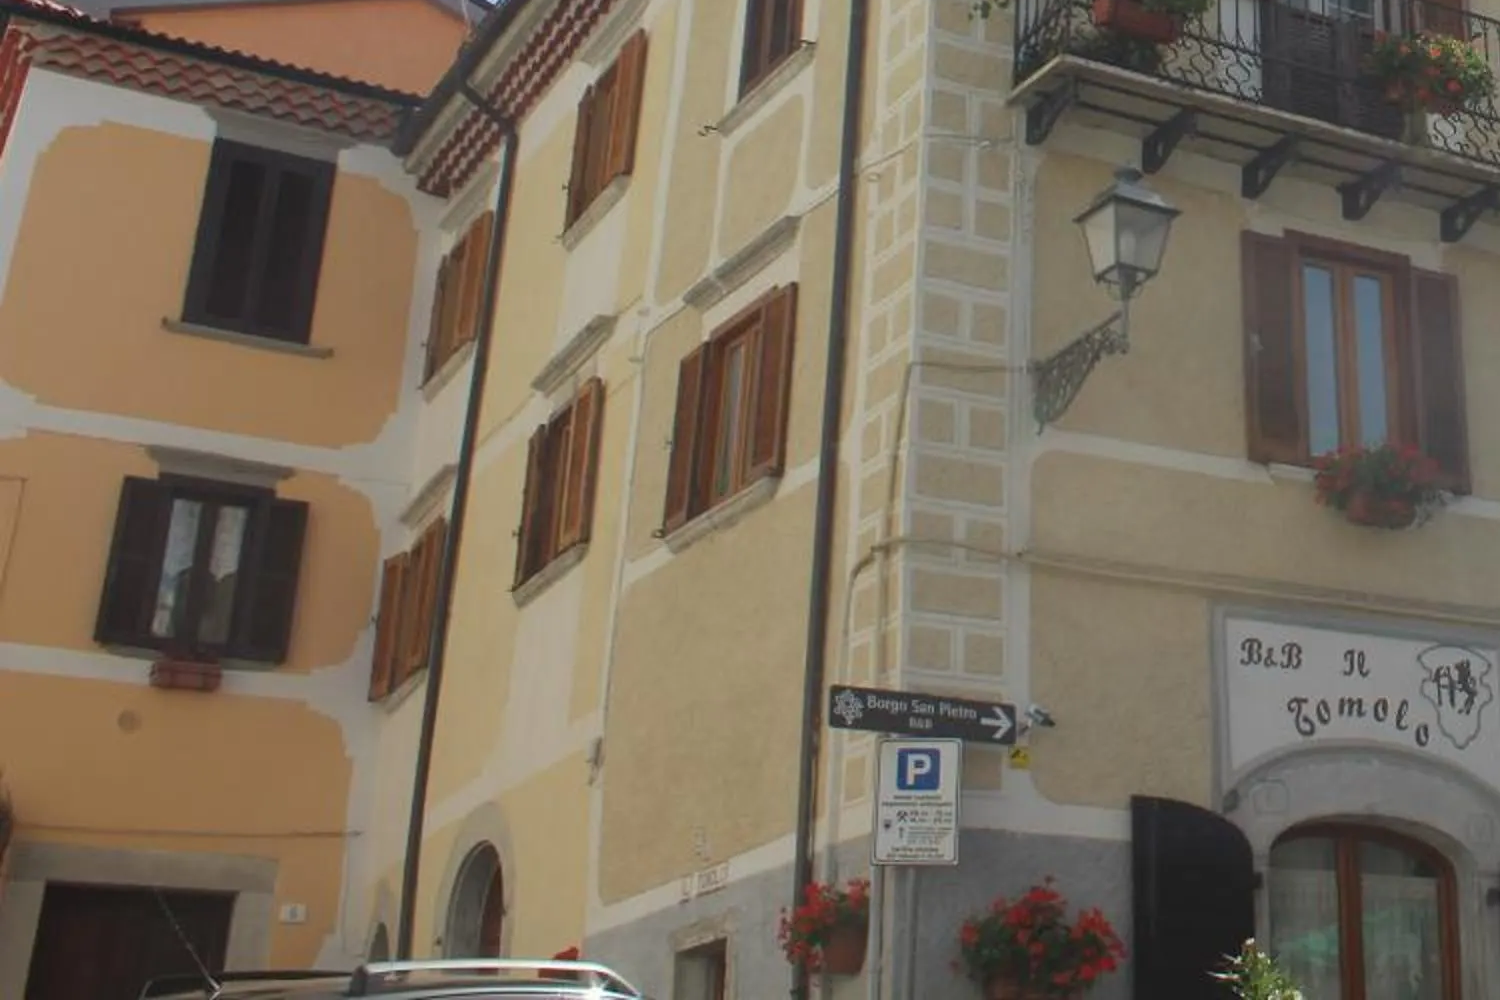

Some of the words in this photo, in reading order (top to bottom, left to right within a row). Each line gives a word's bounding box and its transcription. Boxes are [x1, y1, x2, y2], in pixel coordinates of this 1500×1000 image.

[1240, 638, 1302, 670] B&B
[1343, 649, 1370, 678] Il
[867, 695, 908, 715] Borgo
[911, 699, 935, 714] San
[940, 701, 977, 719] Pietro
[1287, 696, 1430, 748] Tomolo
[905, 753, 932, 786] P
